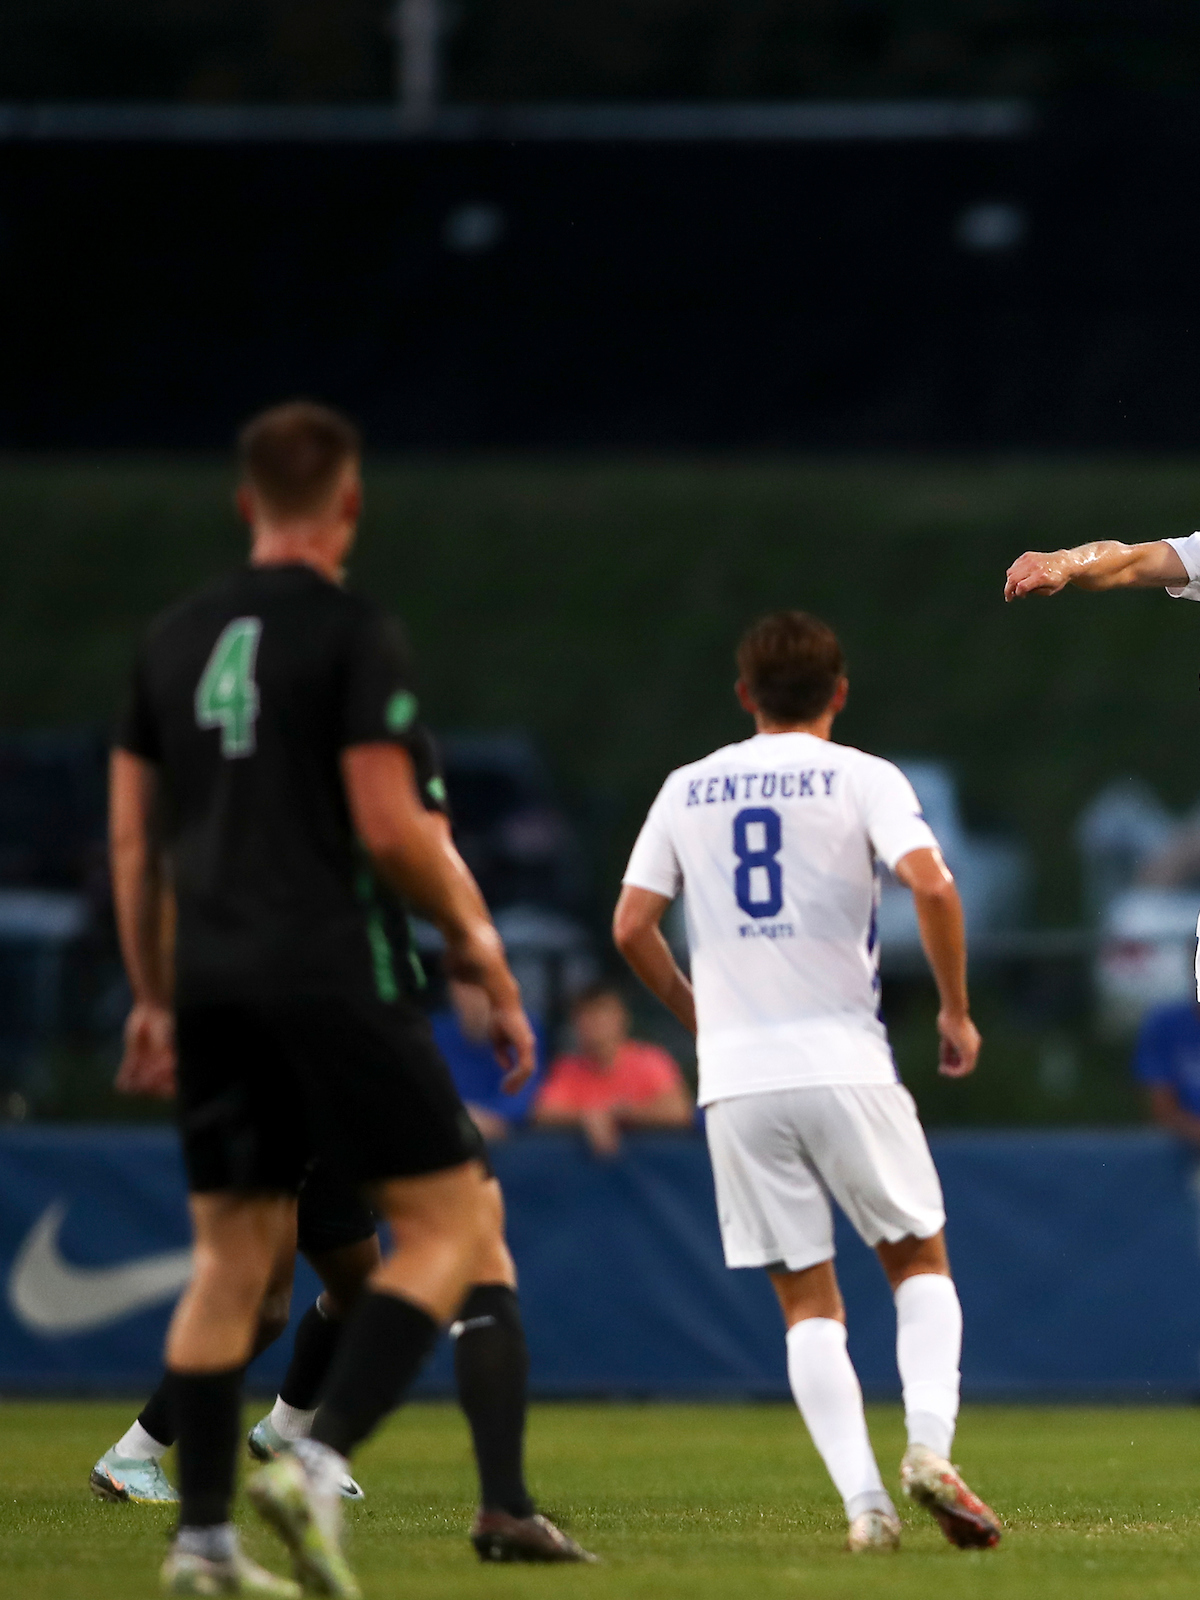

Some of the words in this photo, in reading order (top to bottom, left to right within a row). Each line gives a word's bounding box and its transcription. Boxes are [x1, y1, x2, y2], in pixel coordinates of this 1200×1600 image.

[194, 615, 262, 759] 4
[687, 769, 836, 807] KENTUCKY
[733, 806, 783, 918] 8
